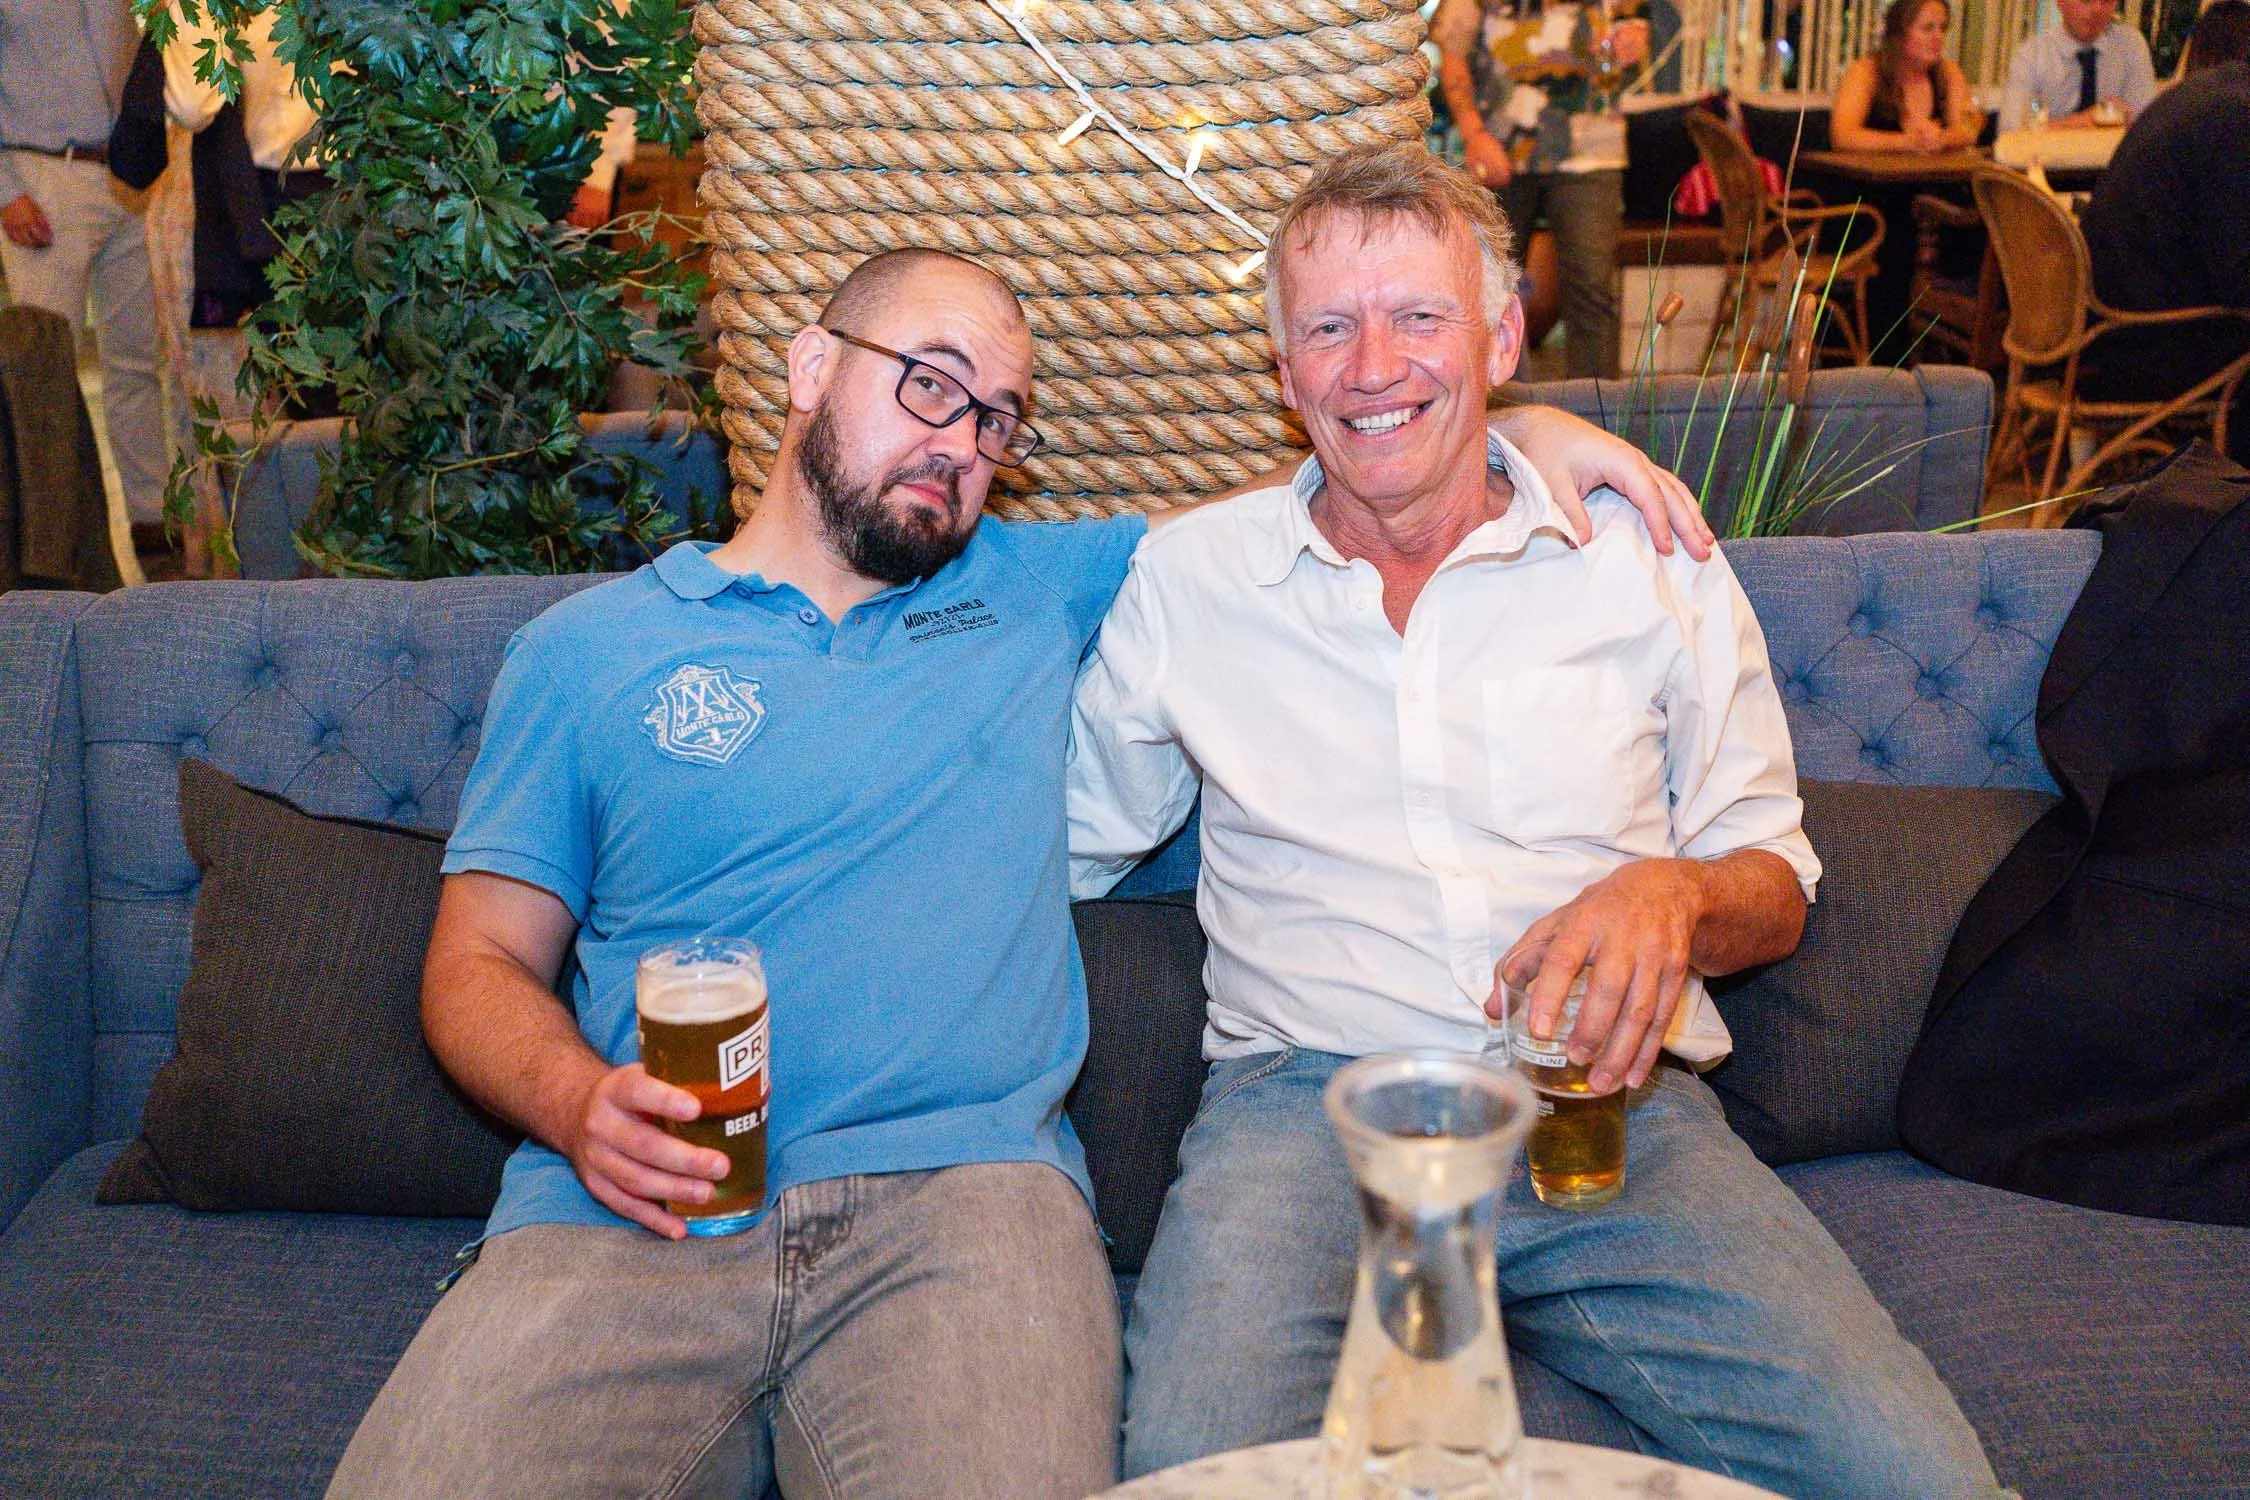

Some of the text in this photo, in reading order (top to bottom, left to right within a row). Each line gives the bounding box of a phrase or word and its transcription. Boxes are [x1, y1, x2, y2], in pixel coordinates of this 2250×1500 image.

[902, 599, 985, 631] MONTE CARLO
[725, 1110, 760, 1137] BEER.
